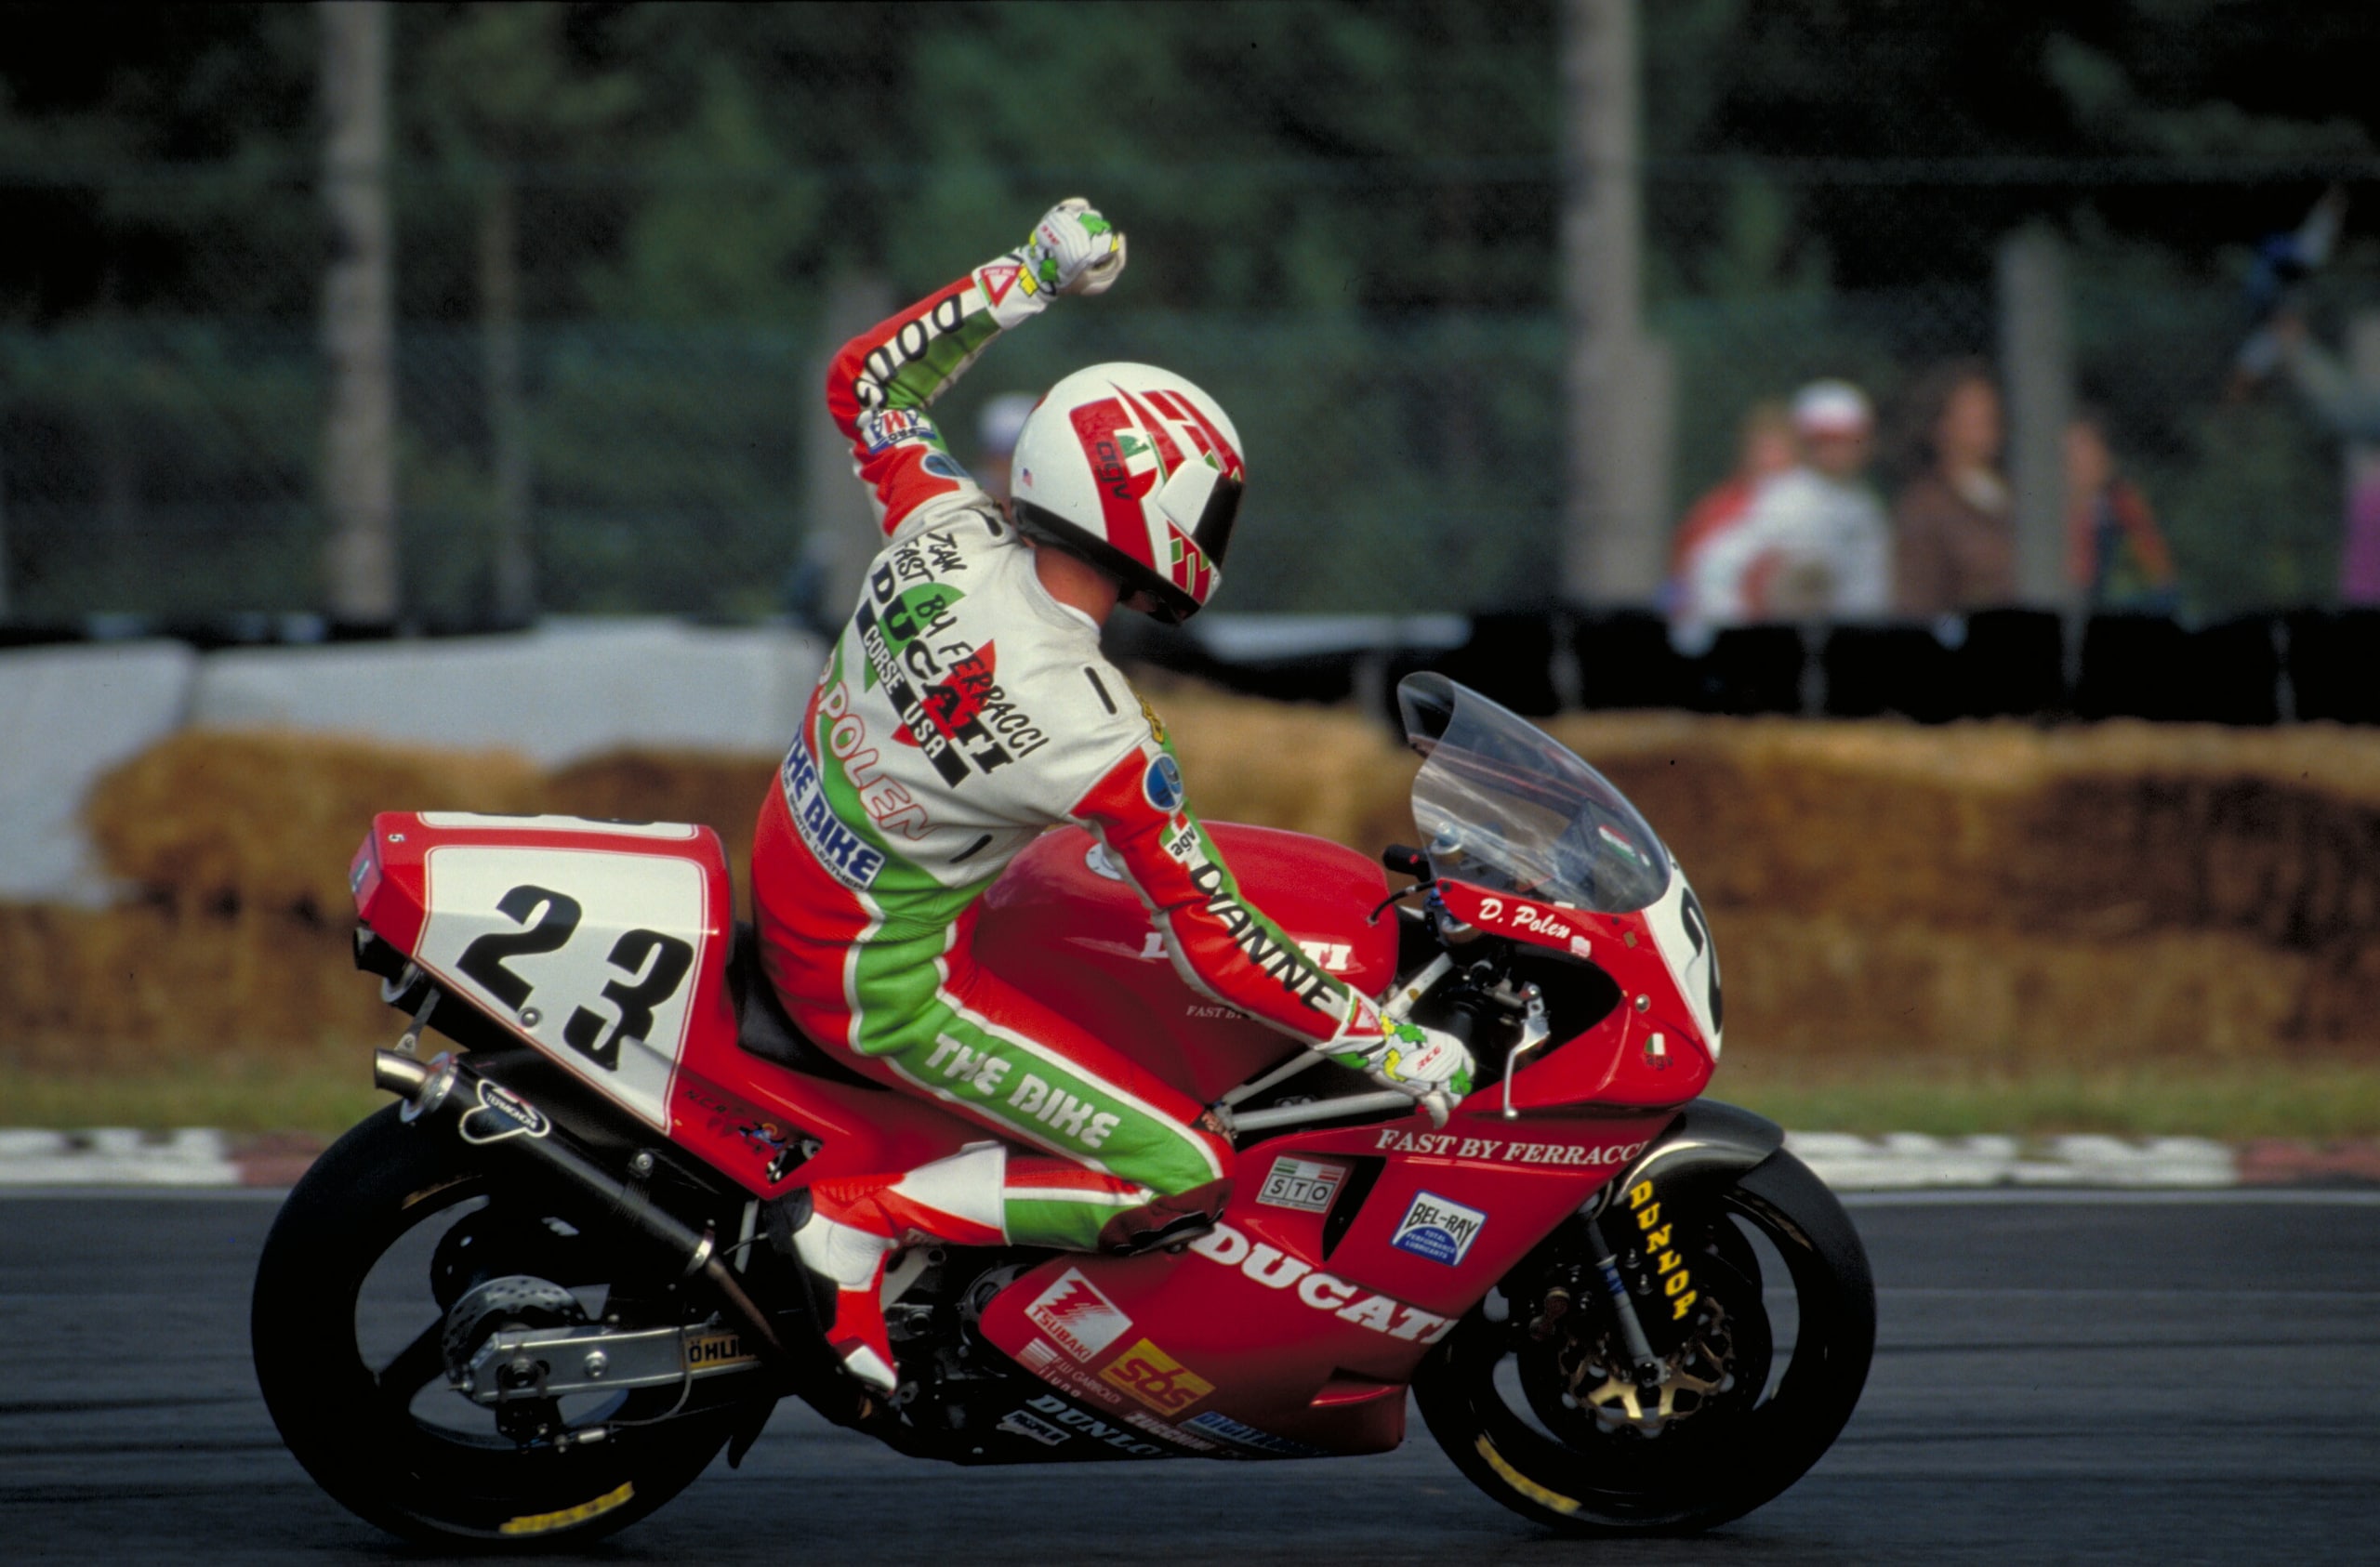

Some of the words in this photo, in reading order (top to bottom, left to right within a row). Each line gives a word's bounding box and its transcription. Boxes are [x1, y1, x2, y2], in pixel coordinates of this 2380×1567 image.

[1097, 441, 1132, 500] agv
[927, 532, 968, 573] TEAM
[871, 561, 1014, 775] DUCATI
[893, 536, 935, 583] FAST
[937, 640, 1050, 758] FERRACCI
[863, 624, 906, 695] CORSE
[901, 705, 947, 759] USA
[817, 679, 935, 841] POLEN
[803, 791, 882, 884] BIKE
[1170, 826, 1197, 857] agv
[1190, 861, 1333, 1013] DIANNE
[1512, 905, 1571, 940] Polen
[456, 884, 694, 1072] 23
[925, 1033, 1012, 1096] THE
[1007, 1073, 1120, 1149] BIKE
[1375, 1129, 1457, 1156] FAST
[1458, 1134, 1501, 1159] BY
[1270, 1179, 1328, 1201] STO
[1404, 1202, 1479, 1248] BEL-RAY
[1629, 1180, 1700, 1321] DUNLOP
[1033, 1306, 1093, 1363] TSUBAKI
[1025, 1394, 1170, 1456] DUNLO
